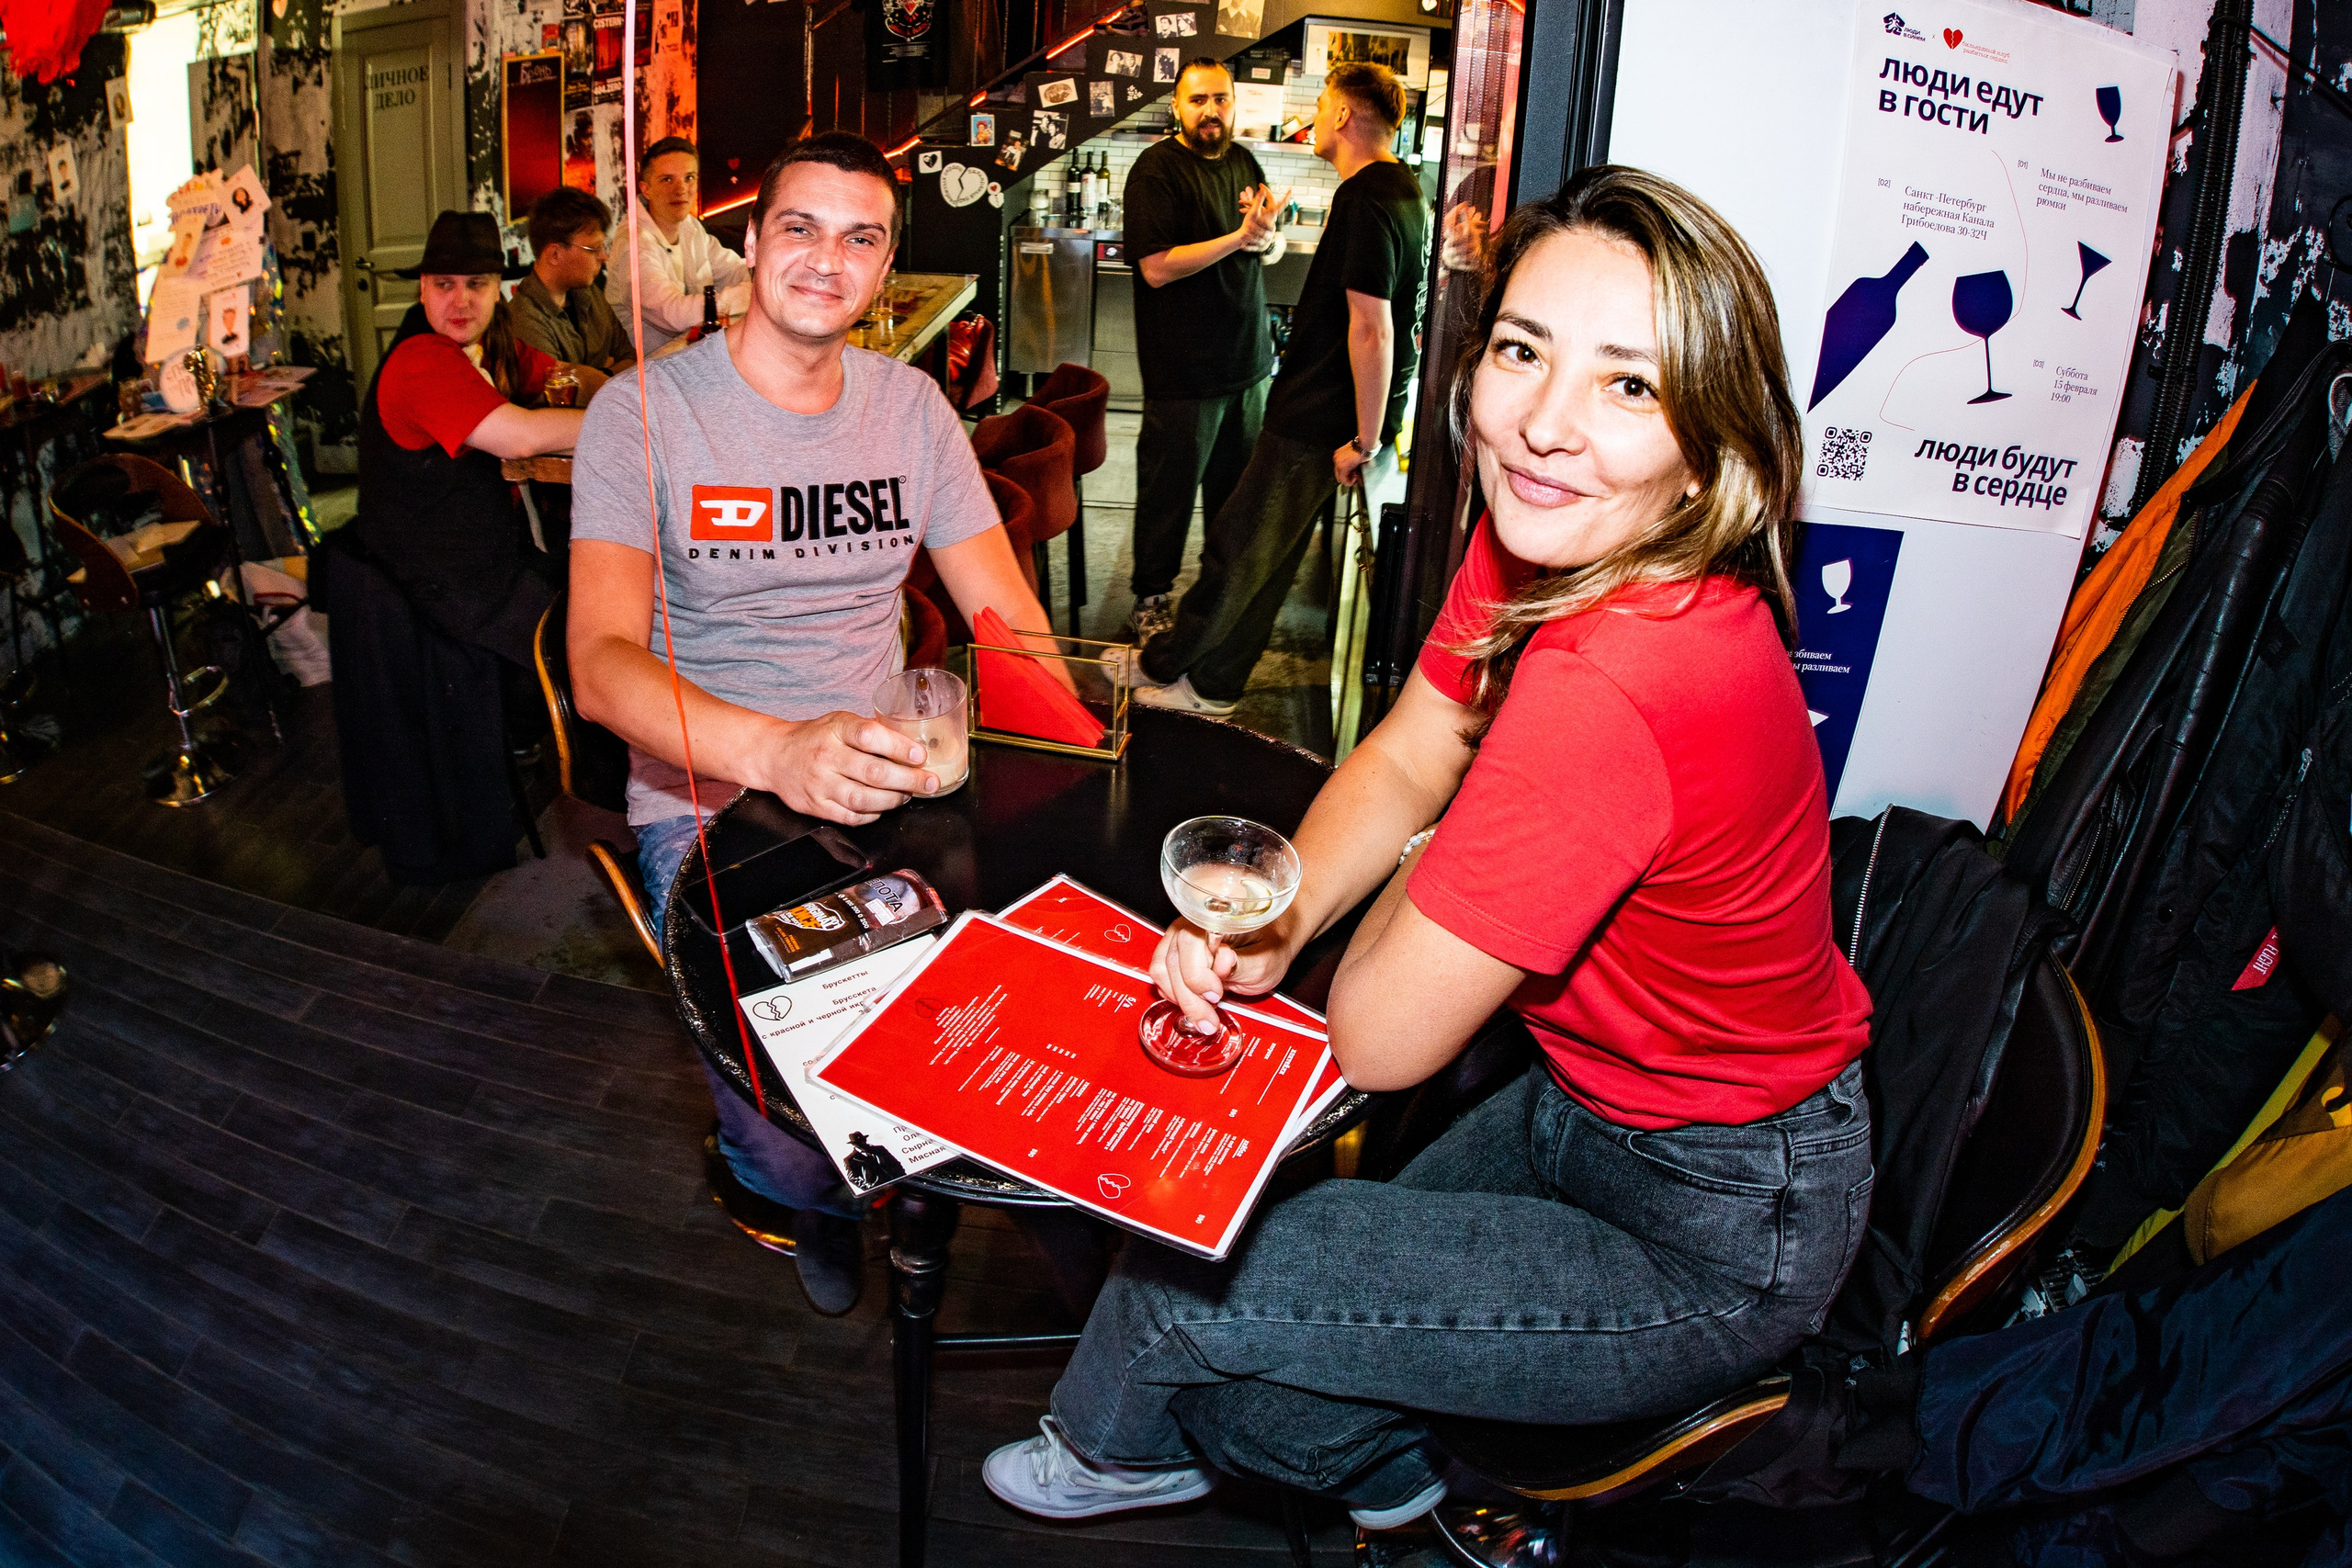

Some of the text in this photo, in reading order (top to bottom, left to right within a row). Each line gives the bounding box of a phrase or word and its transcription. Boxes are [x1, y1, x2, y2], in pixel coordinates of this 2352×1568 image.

[1879, 58, 2044, 119] люди едут
[373, 89, 416, 110] ДЕЛО
[1879, 89, 1989, 135] в гости
[1877, 177, 1892, 188] [02]
[2041, 168, 2112, 197] Мы не разбиваем
[1905, 186, 1935, 201] Санкт
[2036, 197, 2066, 211] рюмки
[2038, 182, 2129, 214] сердца, мы разливаем
[1901, 213, 1956, 235] Грибоедова
[1903, 200, 1996, 229] набережная Канала
[2055, 366, 2089, 381] Суббота
[2051, 392, 2071, 404] 19:00
[2053, 379, 2098, 397] 15 февраля
[1914, 439, 2078, 483] люди будут
[1951, 472, 2068, 511] в сердце
[689, 535, 914, 559] DENIM DIVISION
[1801, 663, 1851, 673] разливаем
[860, 918, 870, 930] 200
[2252, 944, 2278, 975] FLIGHT
[822, 970, 869, 990] Брускетты
[832, 987, 876, 1005] Брусскета
[770, 1021, 807, 1037] красной
[816, 1006, 847, 1021] черной
[908, 1145, 946, 1164] Мясная
